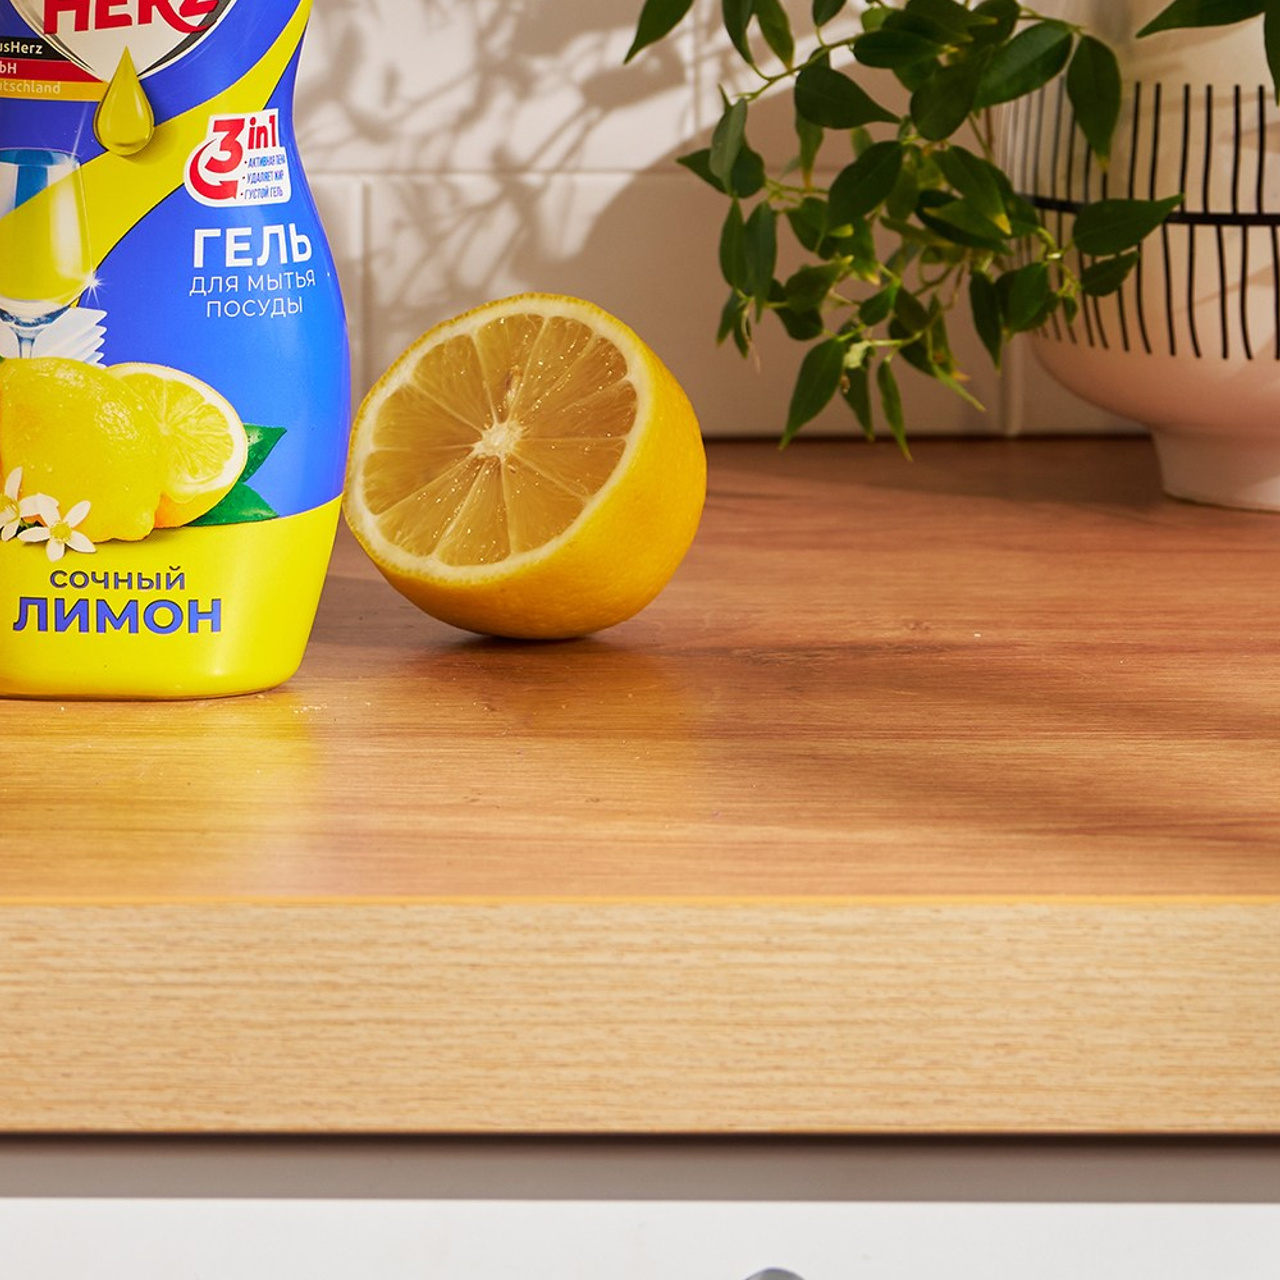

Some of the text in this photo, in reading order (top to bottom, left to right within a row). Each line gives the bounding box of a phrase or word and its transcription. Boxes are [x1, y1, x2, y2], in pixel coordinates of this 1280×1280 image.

[193, 222, 313, 268] ГЕЛЬ
[189, 269, 316, 297] ДЛЯ МЫТЬЯ
[206, 296, 303, 318] ПОСУДЫ
[12, 596, 222, 635] ЛИМОН
